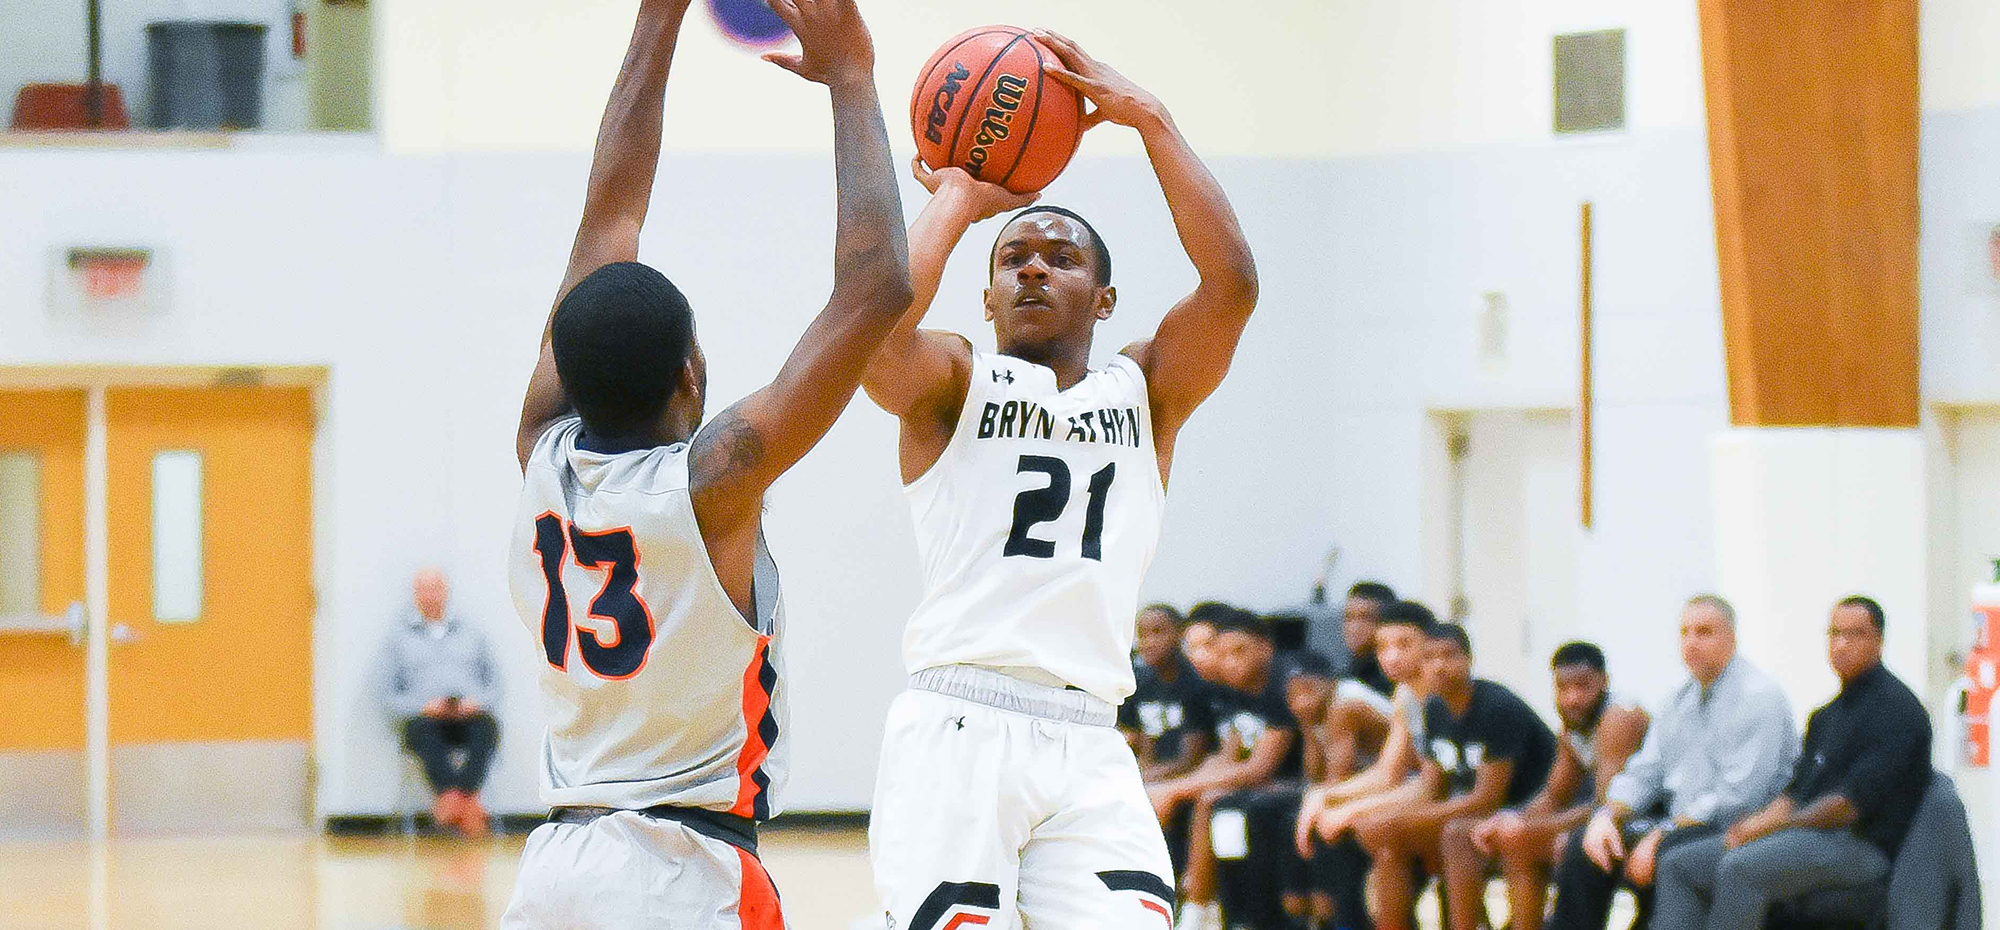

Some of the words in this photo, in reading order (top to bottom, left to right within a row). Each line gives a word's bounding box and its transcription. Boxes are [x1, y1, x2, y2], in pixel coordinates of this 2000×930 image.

[925, 61, 970, 145] NCAA
[964, 74, 1029, 179] Wilson
[977, 401, 1055, 440] BRYN
[1066, 406, 1140, 448] ATHYN
[1003, 455, 1116, 562] 21
[533, 509, 656, 680] 13
